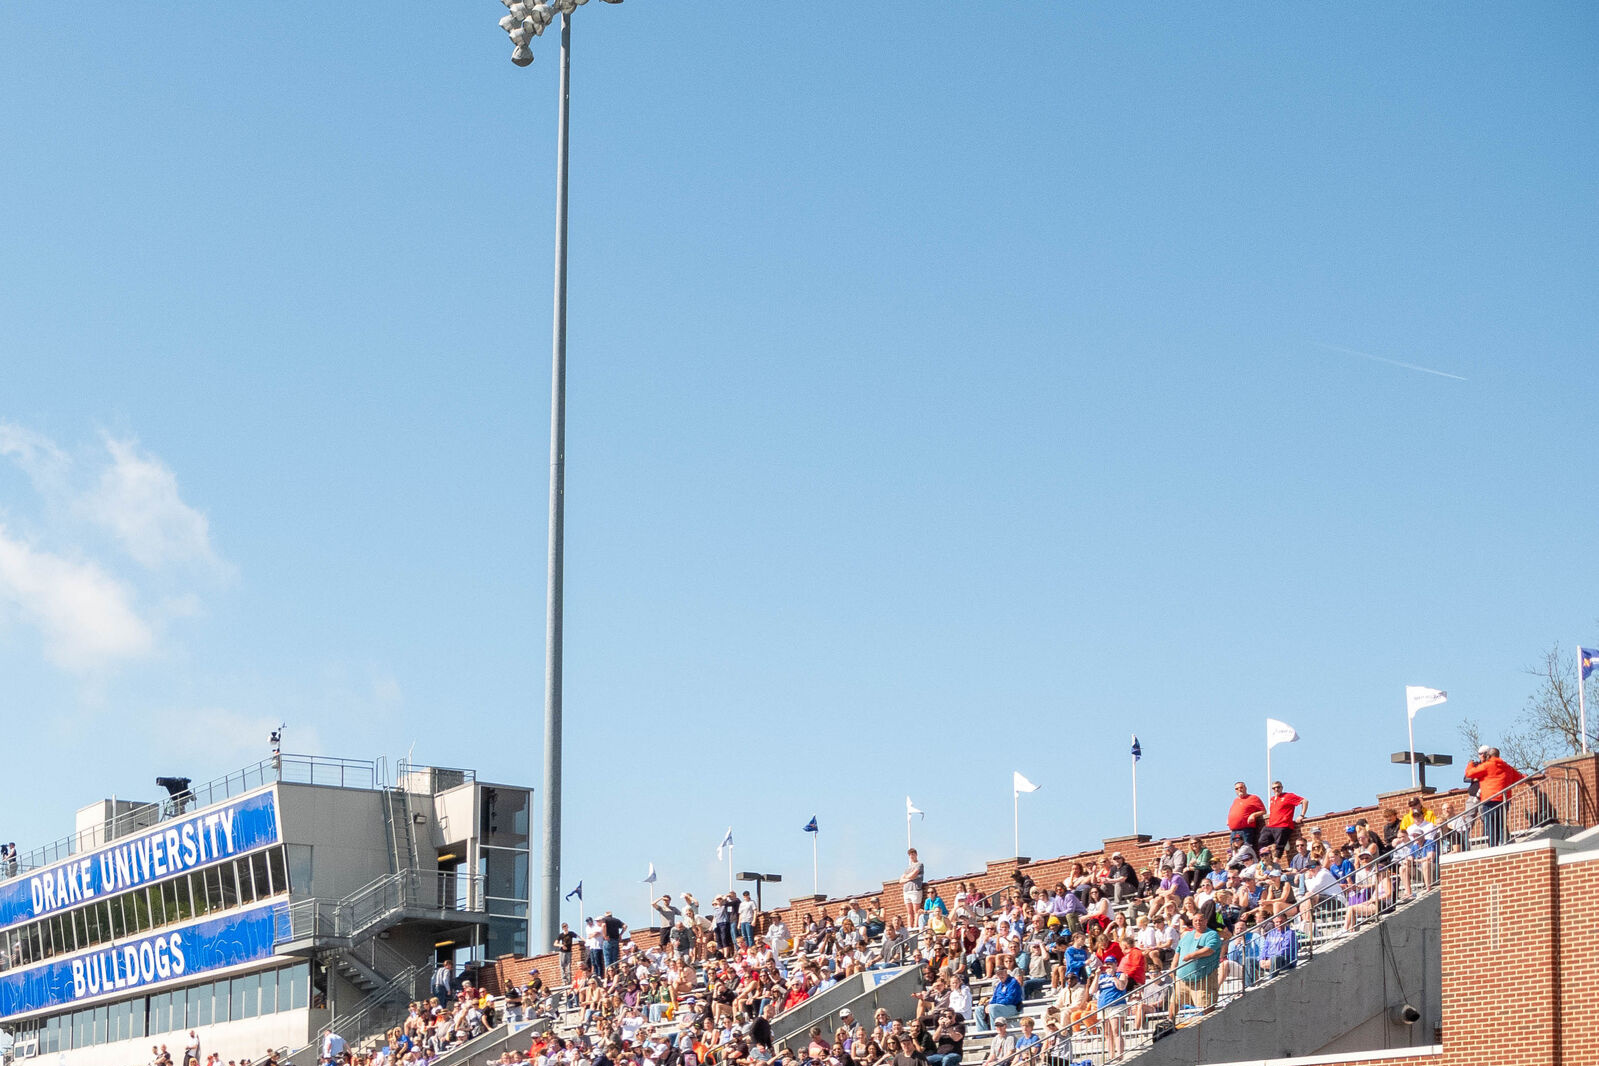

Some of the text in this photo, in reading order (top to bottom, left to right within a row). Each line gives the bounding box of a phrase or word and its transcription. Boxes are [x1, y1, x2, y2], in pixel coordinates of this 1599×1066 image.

[30, 808, 235, 915] DRAKE UNIVERSITY
[72, 932, 186, 998] BULLDOGS
